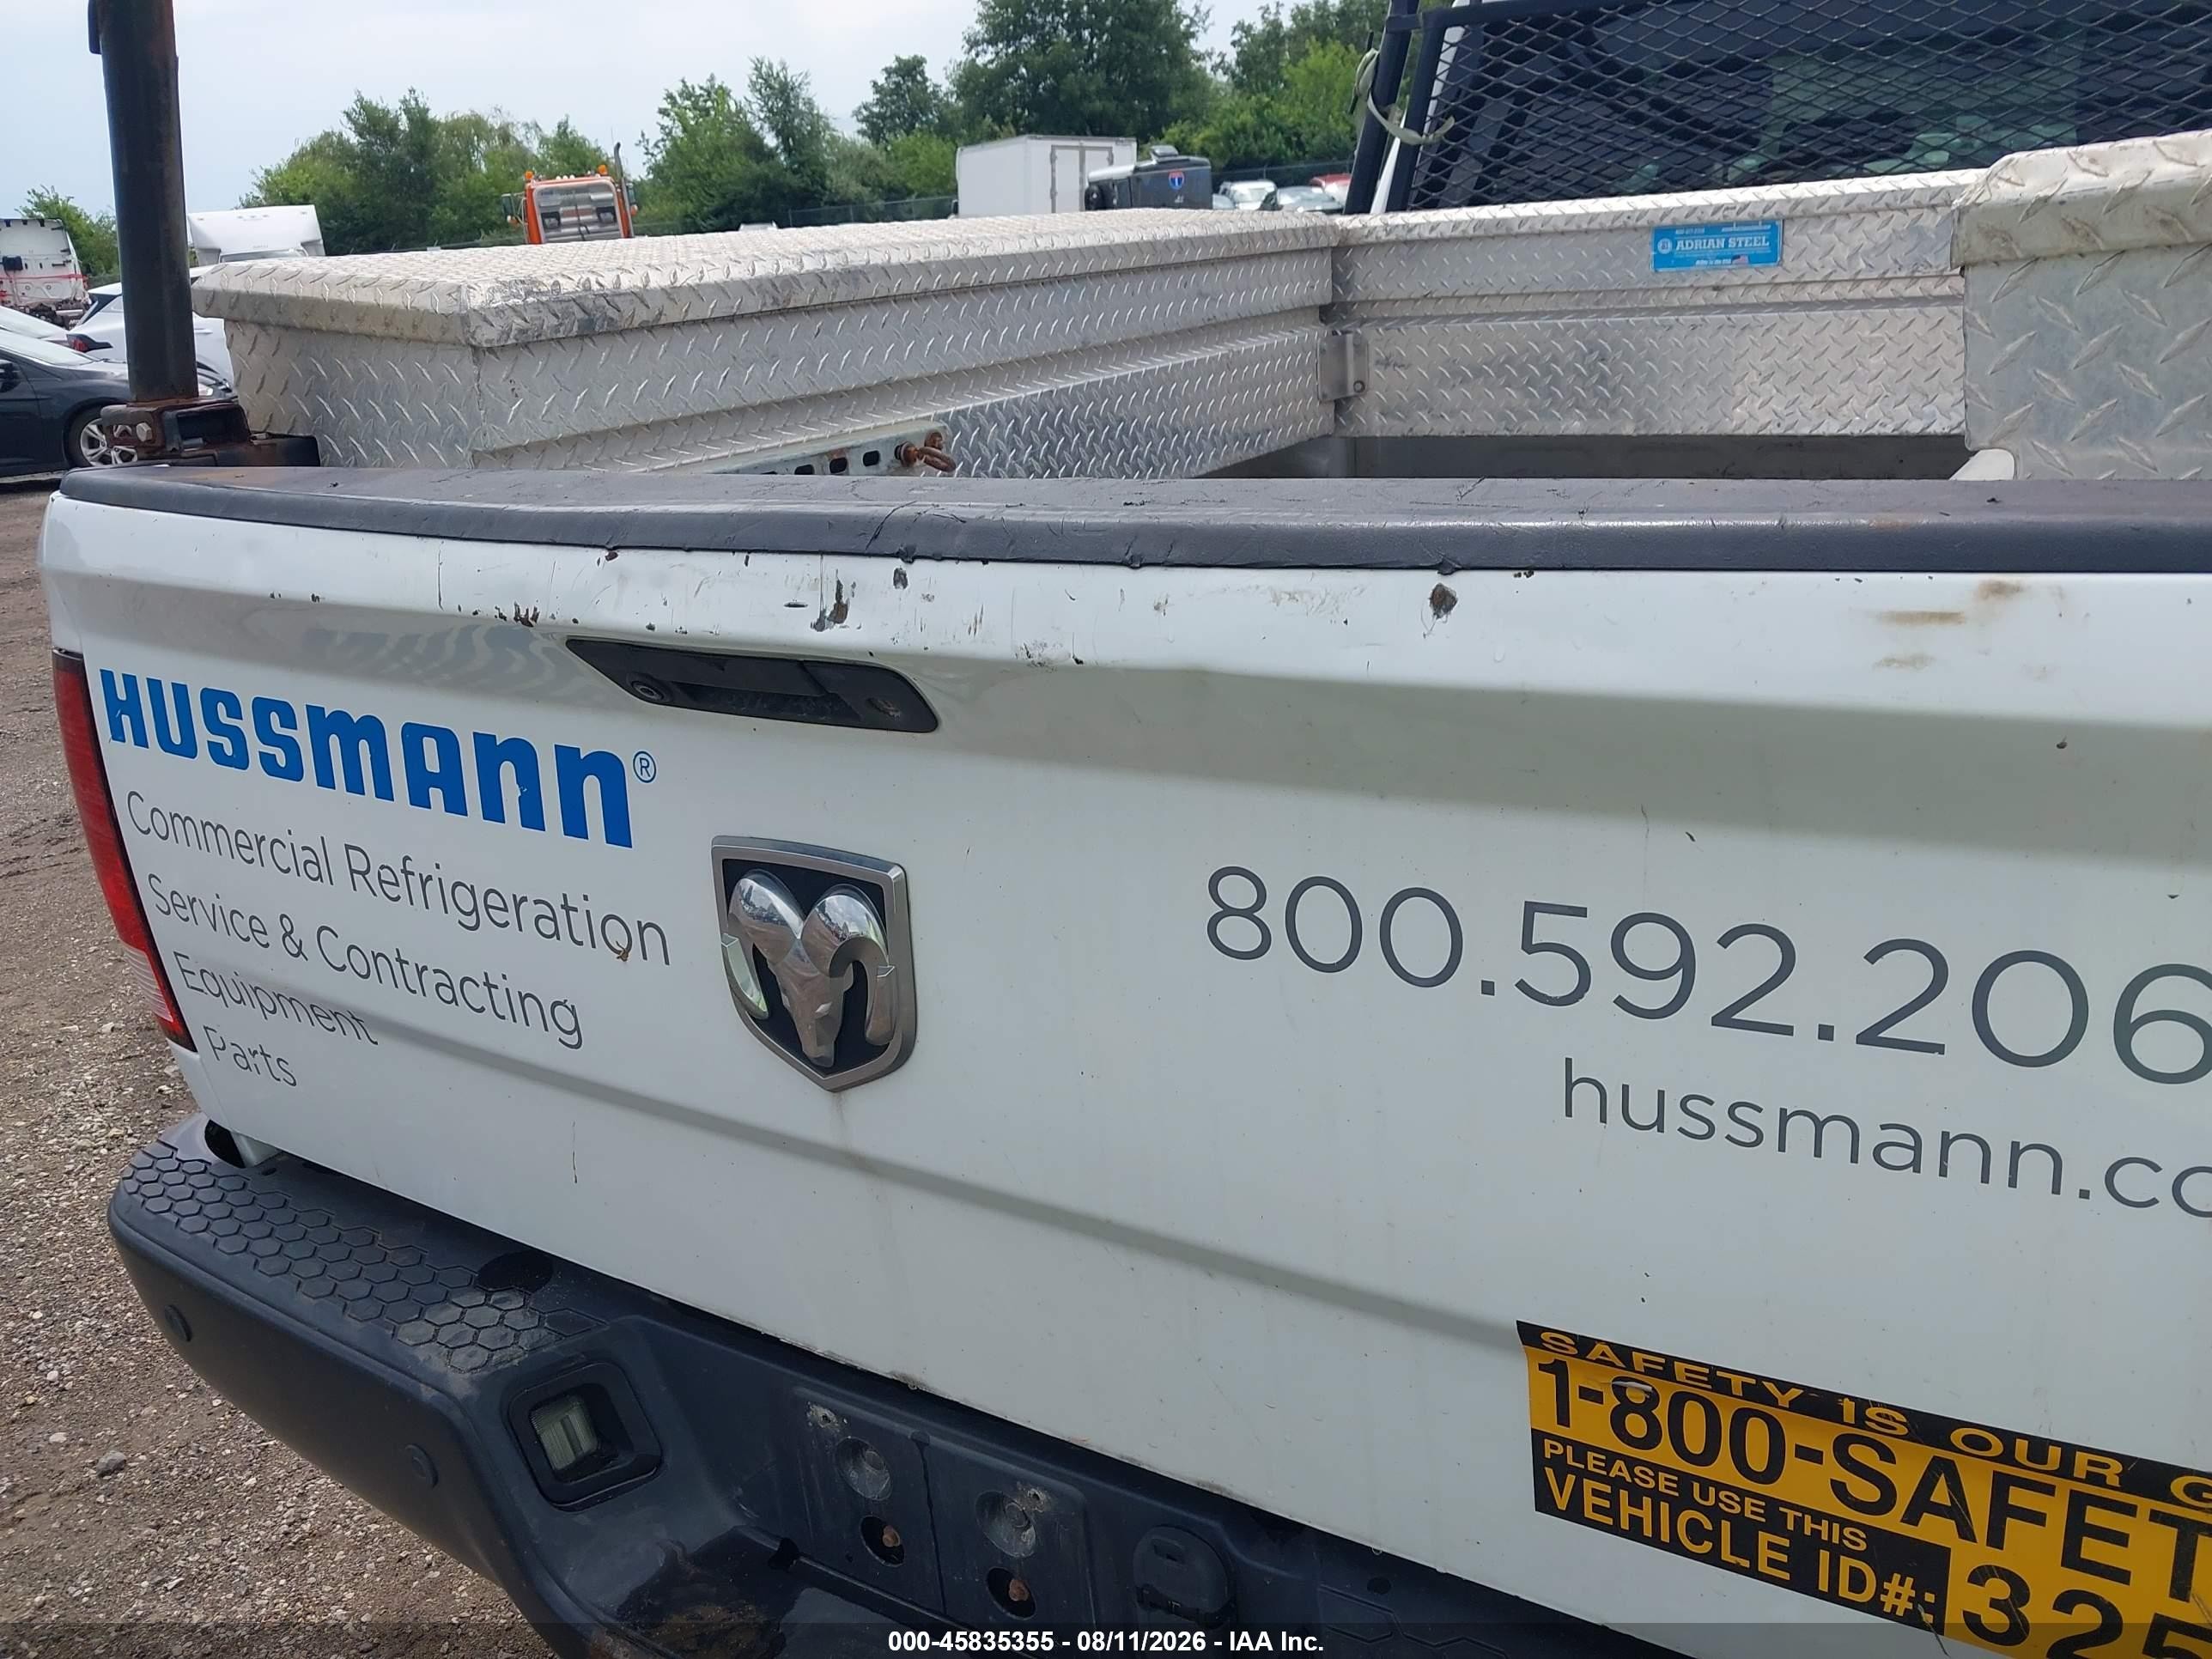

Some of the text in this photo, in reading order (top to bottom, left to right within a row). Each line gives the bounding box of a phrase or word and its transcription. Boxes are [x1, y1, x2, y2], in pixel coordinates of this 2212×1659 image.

[1675, 239, 1725, 251] ADRIAN
[1728, 235, 1770, 248] STEEL
[127, 791, 670, 965] Commercial Refrigeration
[148, 873, 583, 1049] Service & Contracting
[174, 951, 379, 1045] Equipment
[1206, 865, 2212, 1085] 800.592.206
[204, 1025, 297, 1087] Parts
[1538, 1358, 2212, 1604] 1-800-SAFET
[1540, 1331, 1804, 1408] SAFETY
[1840, 1398, 1908, 1436] IS
[1950, 1427, 2124, 1487] OUR
[1544, 1439, 1868, 1551] PLEASE USE THIS
[1544, 1467, 1790, 1581] VEHICLE
[1818, 1549, 1936, 1625] ID#:
